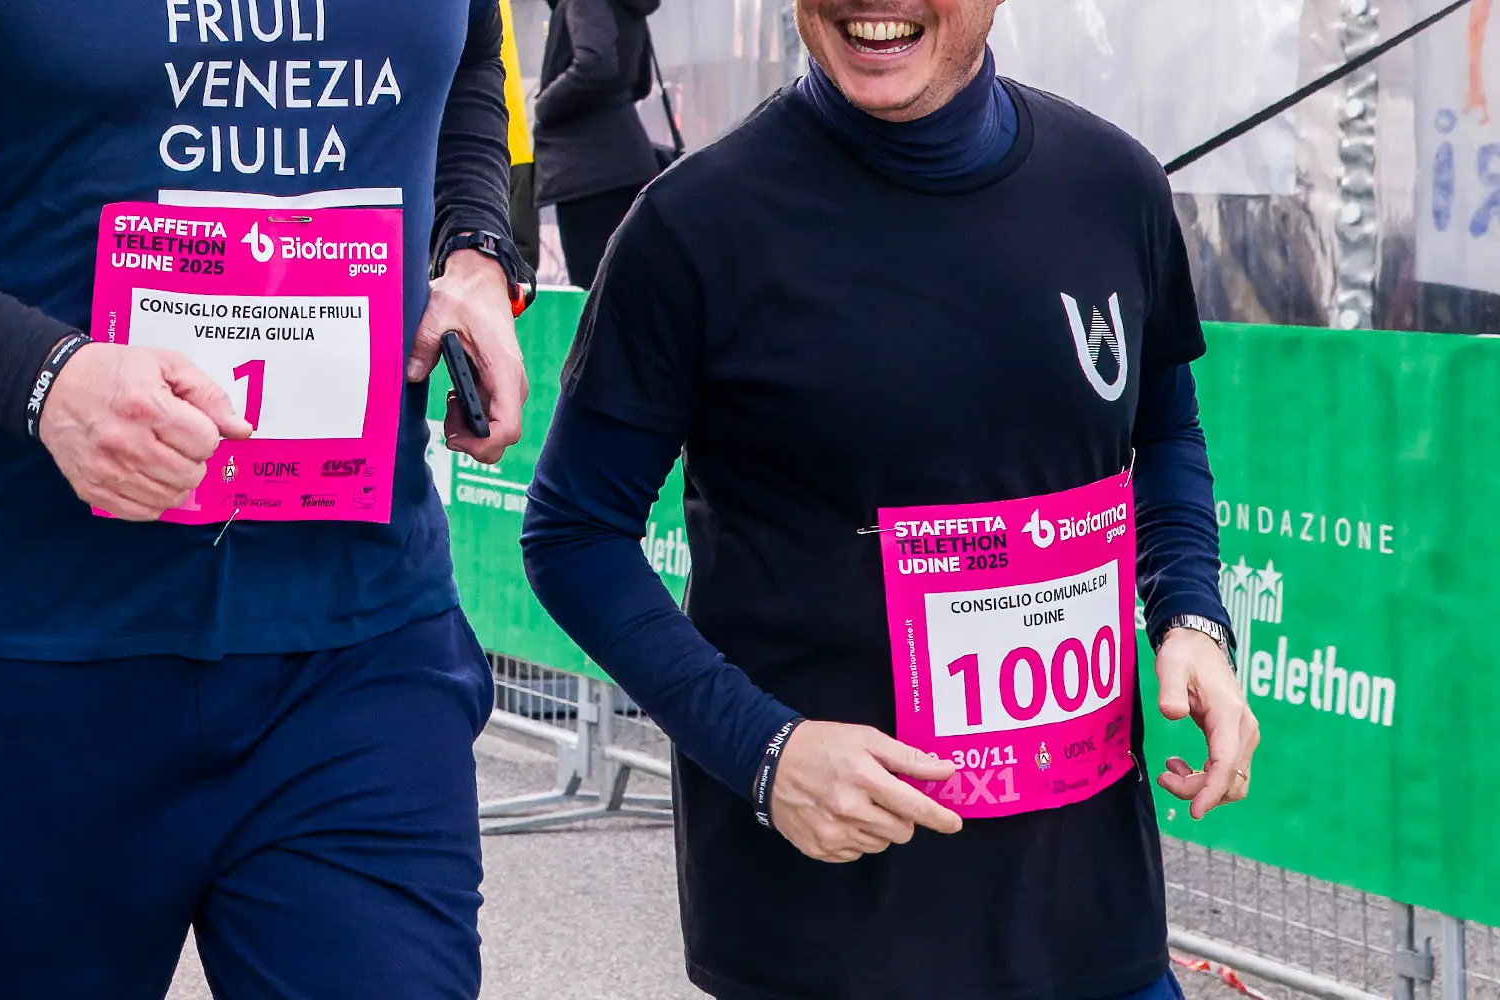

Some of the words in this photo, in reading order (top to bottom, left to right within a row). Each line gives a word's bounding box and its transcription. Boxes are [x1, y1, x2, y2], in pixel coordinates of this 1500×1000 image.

[164, 57, 401, 110] VENEZIA
[159, 124, 347, 176] GIULIA
[114, 215, 228, 239] STAFFETTA
[112, 233, 225, 256] TELETHON
[279, 236, 388, 260] Biofarma
[111, 253, 173, 272] UDINE
[179, 258, 224, 275] 2025
[349, 262, 387, 277] group
[139, 297, 228, 319] CONSIGLIO
[232, 305, 317, 320] REGIONALE
[320, 305, 362, 320] FRIULI
[194, 324, 261, 341] VENEZIA
[265, 326, 315, 342] GIULIA
[232, 359, 266, 431] 1
[253, 461, 300, 477] UDINE
[894, 515, 1007, 538] STAFFETTA
[1058, 503, 1127, 541] Biofarma
[897, 533, 1007, 556] TELETHON
[1106, 524, 1126, 544] group
[898, 556, 960, 575] UDINE
[966, 552, 1009, 571] 2025
[950, 593, 1032, 614] CONSIGLIO
[1035, 577, 1097, 605] COMUNALE
[1098, 573, 1108, 588] DI
[1023, 608, 1065, 627] UDINE
[947, 625, 1116, 727] 1000
[924, 767, 1021, 805] 4X1
